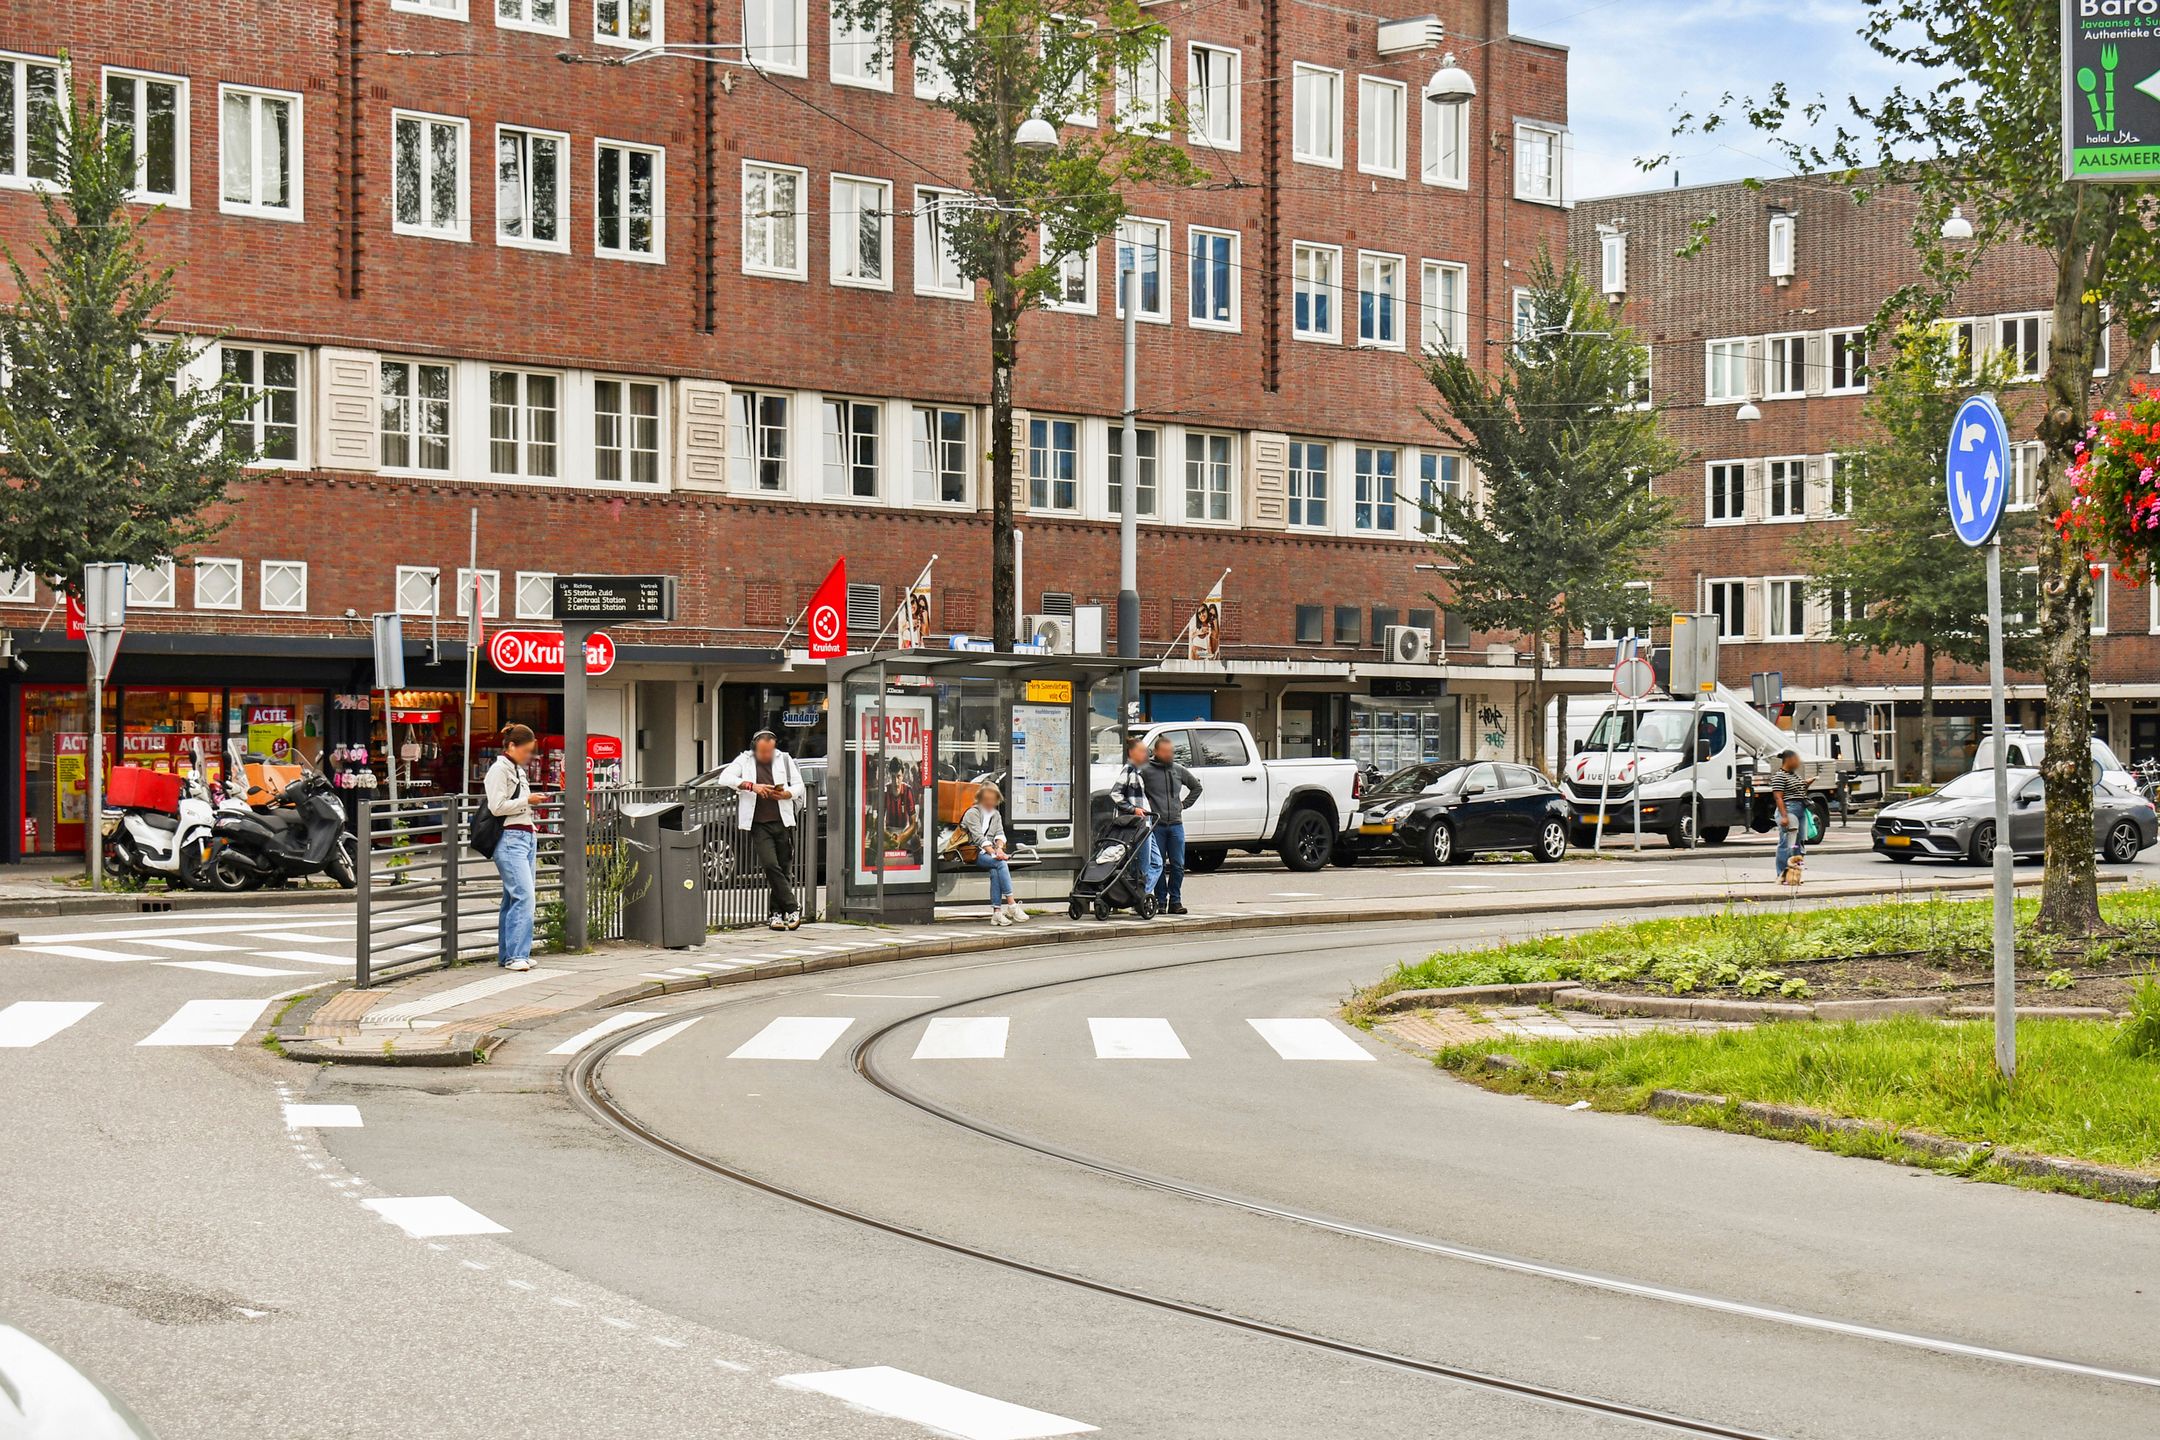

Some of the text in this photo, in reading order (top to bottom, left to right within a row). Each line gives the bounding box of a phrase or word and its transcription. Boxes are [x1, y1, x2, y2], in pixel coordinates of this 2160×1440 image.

[2080, 16, 2160, 29] Javaanse & Su
[2084, 27, 2150, 40] Authentieke
[2086, 133, 2110, 143] halal
[2079, 151, 2160, 167] AALSMEER
[524, 640, 607, 665] Kruiat
[812, 643, 840, 652] Kruidvat
[253, 709, 287, 722] ACTIE
[62, 736, 107, 751] ACT!
